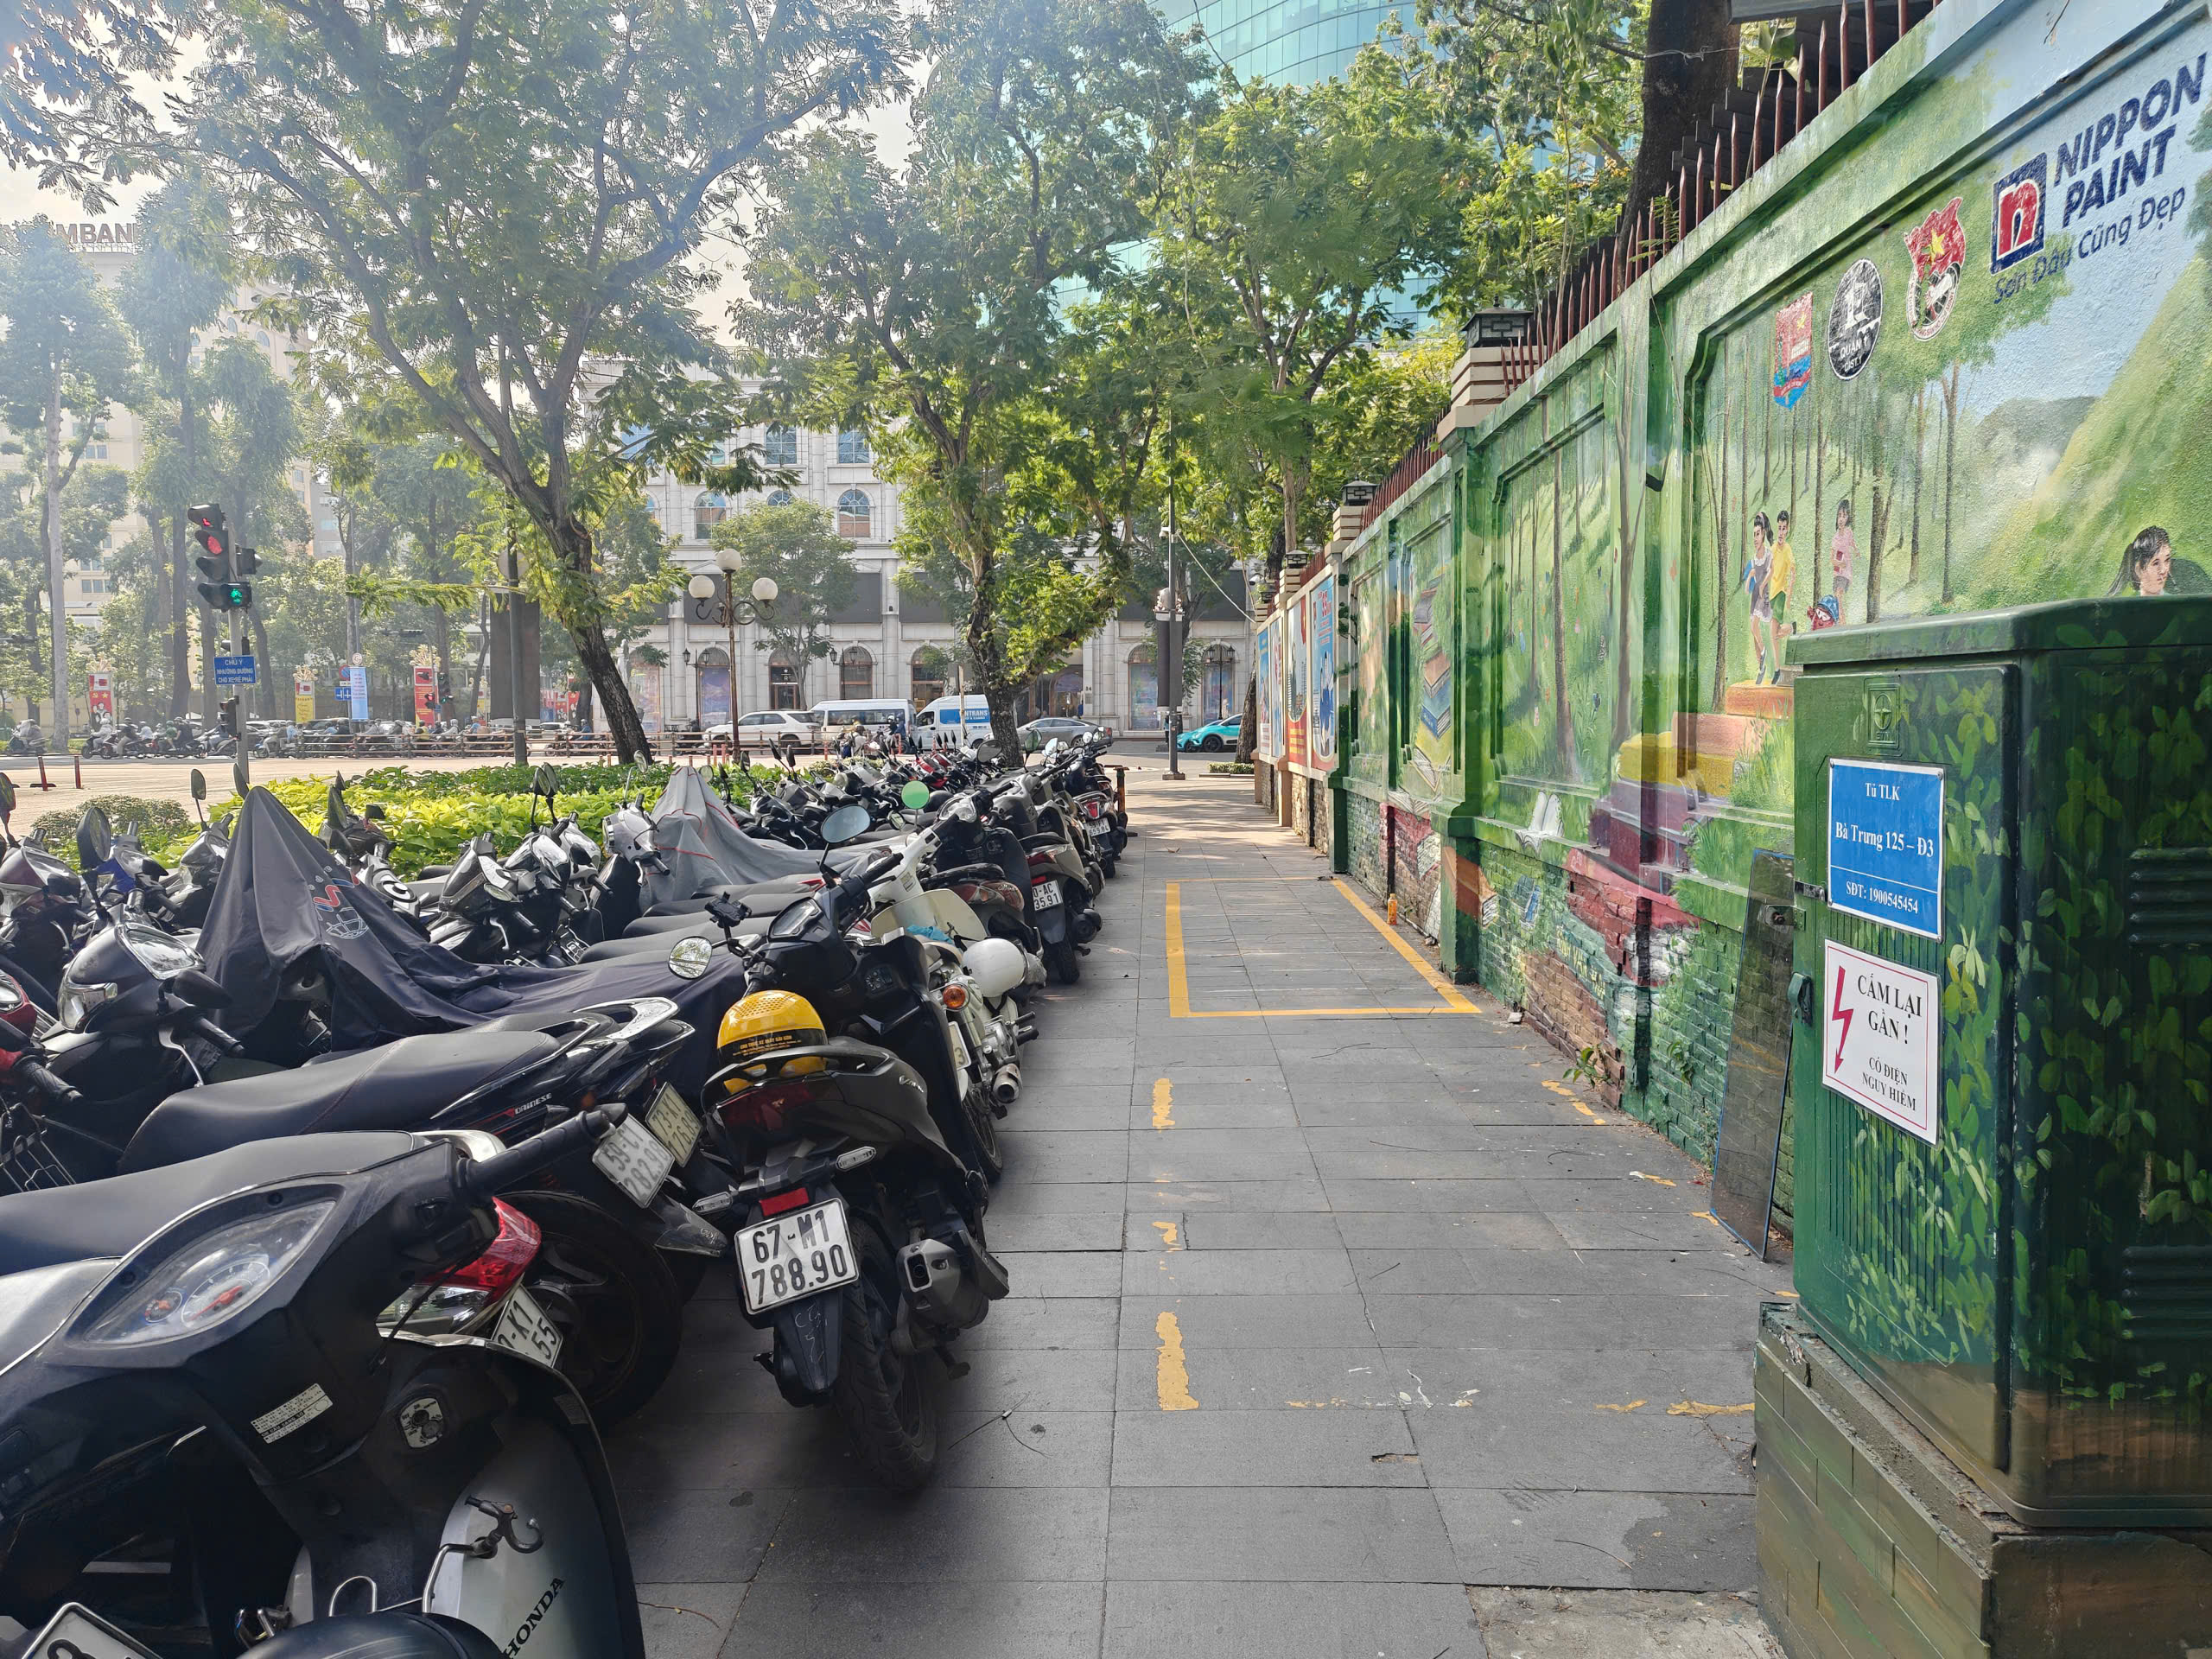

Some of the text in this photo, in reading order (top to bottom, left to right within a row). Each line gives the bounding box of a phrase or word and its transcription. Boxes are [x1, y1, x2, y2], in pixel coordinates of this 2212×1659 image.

[2054, 54, 2206, 187] NIPPON
[2063, 124, 2177, 228] PAINT
[2078, 214, 2133, 259] Cũng
[2139, 187, 2185, 231] Đẹp
[1865, 782, 1900, 801] Tủ TLK
[1835, 822, 1848, 840] Bà
[1851, 825, 1883, 851] Trưng
[1886, 831, 1904, 851] 125
[1917, 836, 1934, 858] Đ3
[1847, 880, 1918, 914] SĐT: 1900545454
[1858, 973, 1923, 1019] CẤM LẠI
[1868, 1008, 1899, 1039] GẦN
[1862, 1072, 1916, 1111] NGUY HIỂM
[1869, 1057, 1908, 1085] CÓ ĐIỆN
[753, 1209, 830, 1263] 67-M1
[752, 1244, 848, 1305] 788.90
[503, 1577, 567, 1659] HONDA
